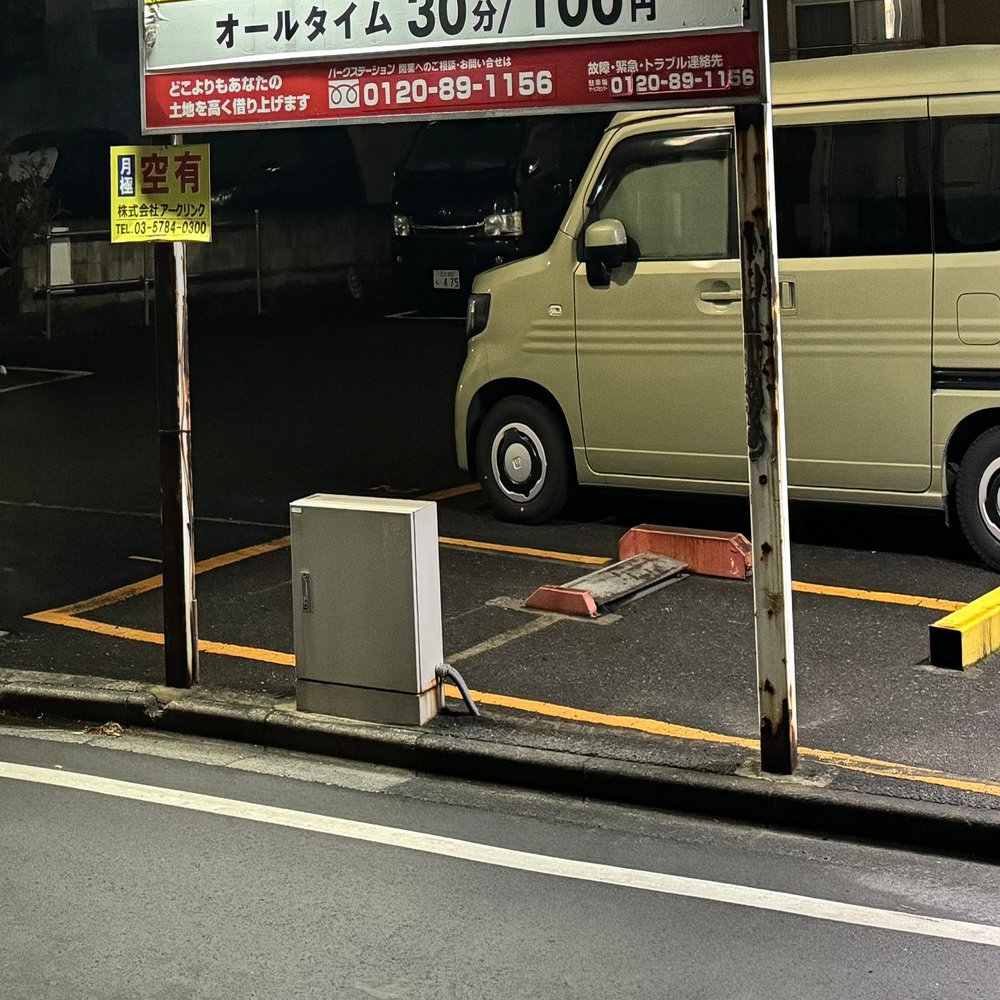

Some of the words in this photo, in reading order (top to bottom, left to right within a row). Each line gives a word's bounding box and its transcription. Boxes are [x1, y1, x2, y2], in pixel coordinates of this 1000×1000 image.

[216, 0, 392, 48] オールタイム
[587, 54, 723, 75] 故障・緊急・トラブル連絡先
[169, 74, 283, 97] どこよりもあなたの
[363, 70, 553, 106] 0120-89-1156
[611, 68, 754, 94] 0120-89-1156
[169, 94, 311, 119] 土地を高く借り上げます
[120, 157, 134, 195] 月極
[118, 203, 205, 218] 株式会社アークリンク
